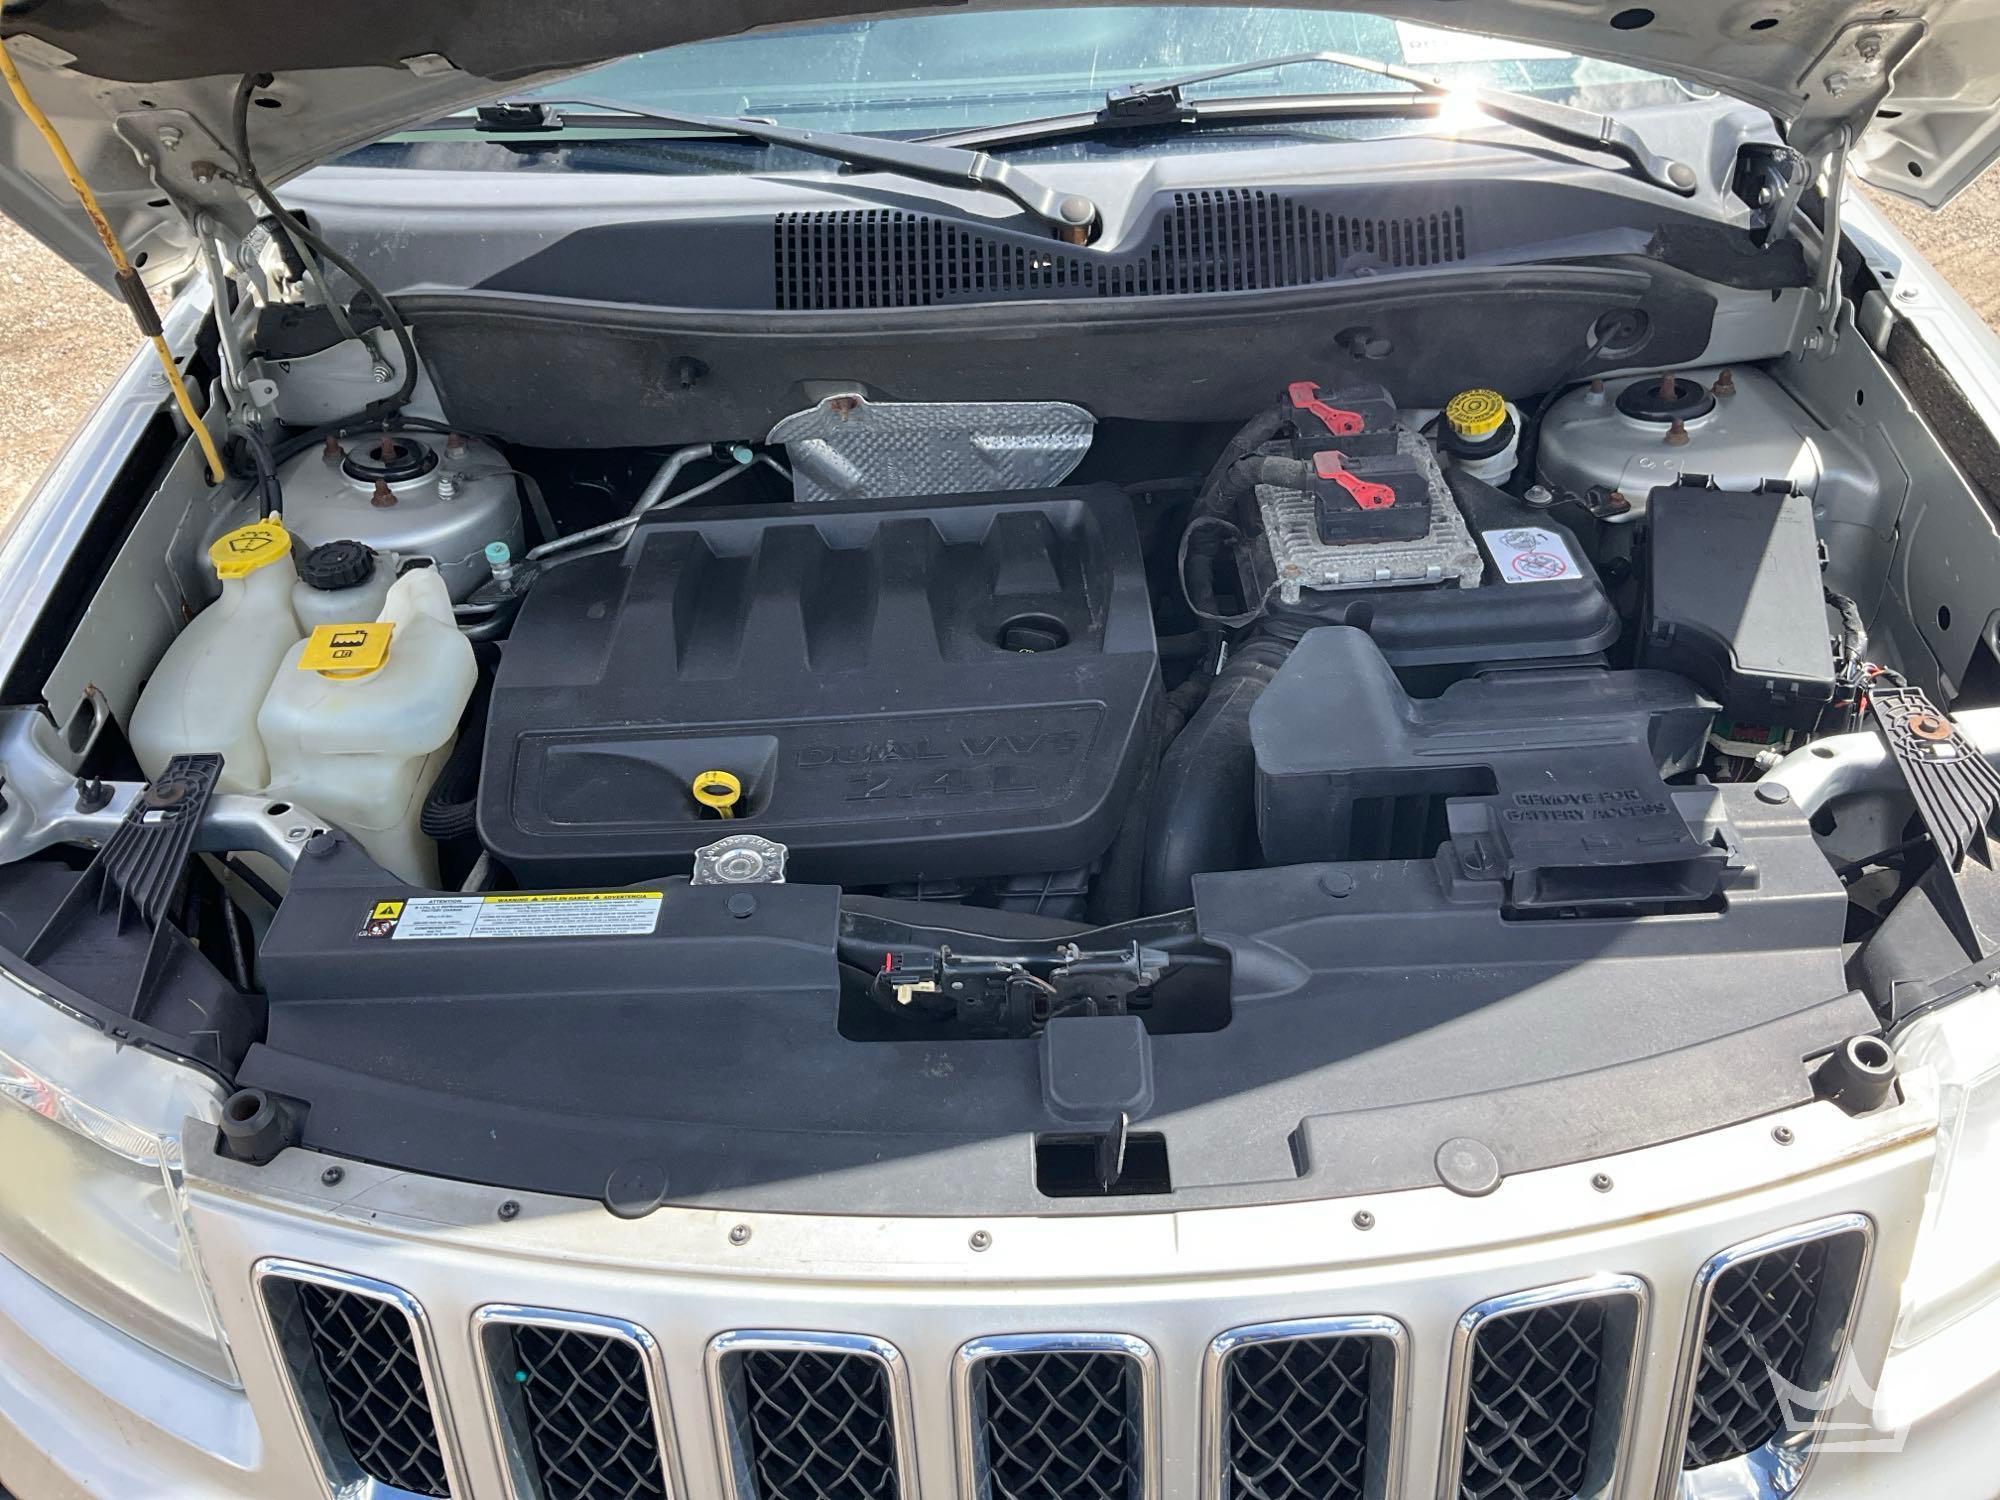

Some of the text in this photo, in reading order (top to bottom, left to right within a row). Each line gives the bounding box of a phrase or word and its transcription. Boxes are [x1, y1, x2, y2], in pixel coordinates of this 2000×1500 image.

[794, 737, 949, 768] DUAL
[1514, 789, 1640, 806] REMOVE FOR
[1506, 802, 1668, 822] BATTERY ACCESS
